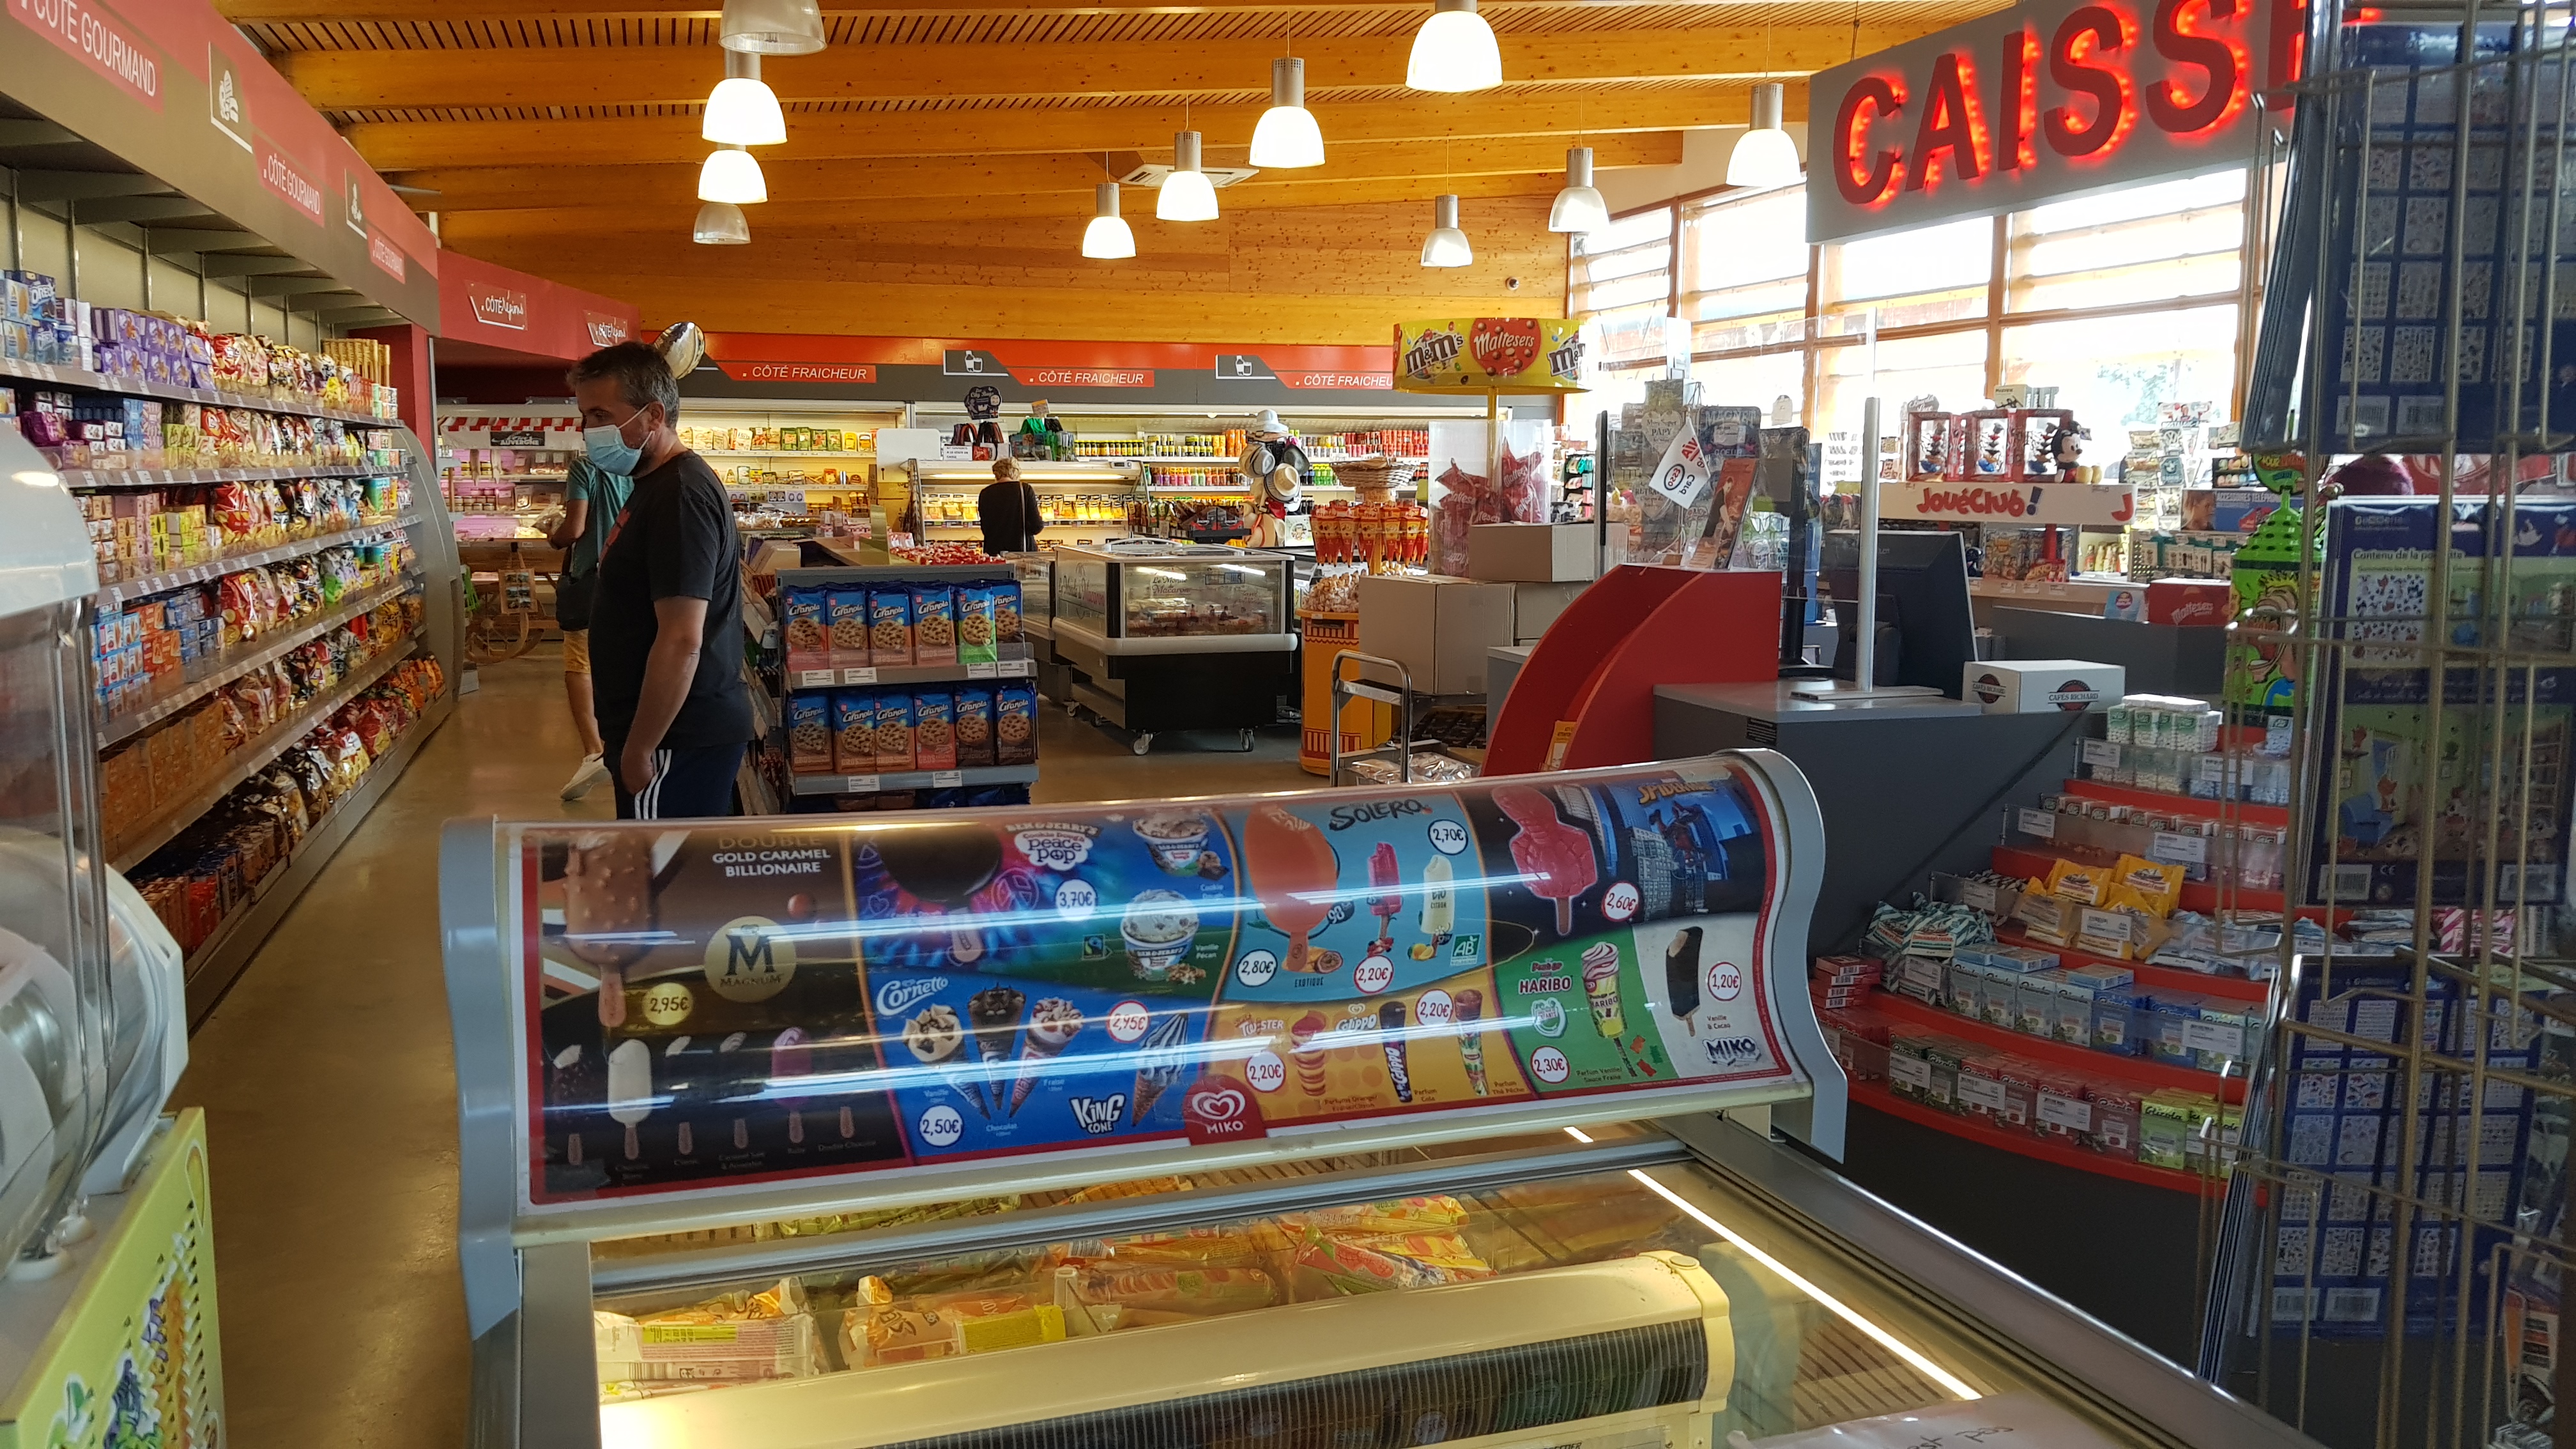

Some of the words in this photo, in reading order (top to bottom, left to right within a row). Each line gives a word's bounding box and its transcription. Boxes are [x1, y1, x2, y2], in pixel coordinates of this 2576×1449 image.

[81, 12, 156, 96] GOURMAND
[268, 153, 287, 192] CÔTÉ
[288, 169, 320, 215] GOURMAND
[1473, 332, 1535, 359] Maltesers
[752, 364, 788, 378] CÔTÉ
[792, 367, 868, 380] FRAICHEUR
[1038, 370, 1073, 383] CÔTÉ
[1075, 372, 1144, 384] FRAICHEUR
[1304, 373, 1336, 386] CÔTÉ
[1338, 376, 1393, 387] FRAICHEU
[2354, 549, 2393, 560] Contenu
[1152, 586, 1191, 594] Macaron
[918, 600, 949, 614] Granola
[962, 599, 990, 613] Granola
[994, 595, 1017, 606] ranola
[788, 604, 820, 616] Granola
[832, 604, 864, 617] Granola
[873, 606, 905, 619] Granola
[2049, 693, 2069, 701] CAFÉS
[2070, 693, 2099, 701] RICHARD
[917, 704, 949, 717] Granola
[956, 701, 987, 713] Granola
[999, 699, 1029, 712] Granola
[793, 707, 825, 721] Granola
[842, 710, 874, 723] Granola
[877, 707, 908, 721] Granola
[1330, 799, 1423, 831] SOLERO
[719, 834, 822, 850] DOUBLE
[1432, 827, 1464, 842] 2,70€
[1029, 838, 1082, 850] peace
[712, 851, 757, 864] GOLD
[759, 848, 831, 861] CARAMEL
[725, 861, 822, 878] BILLIONAIRE
[1059, 891, 1093, 909] 3,70€
[1607, 893, 1636, 912] 2,60€
[726, 934, 775, 976] M
[1240, 960, 1274, 976] 2,80€
[1358, 967, 1389, 982] 2,20€
[719, 974, 782, 987] MAGNUM
[1294, 977, 1324, 988] EXOTIQUE
[1519, 977, 1571, 993] HARIBO
[1711, 974, 1739, 989] 1,20€
[876, 976, 949, 1016] Cornetto
[650, 995, 689, 1014] 2,95€
[1419, 1001, 1450, 1018] 2,20€
[1706, 1038, 1756, 1058] MIKO
[1249, 1064, 1282, 1081] 2,20€
[1534, 1058, 1565, 1074] 2,30€
[922, 1119, 960, 1137] 2,50€
[1206, 1120, 1244, 1135] MIKO
